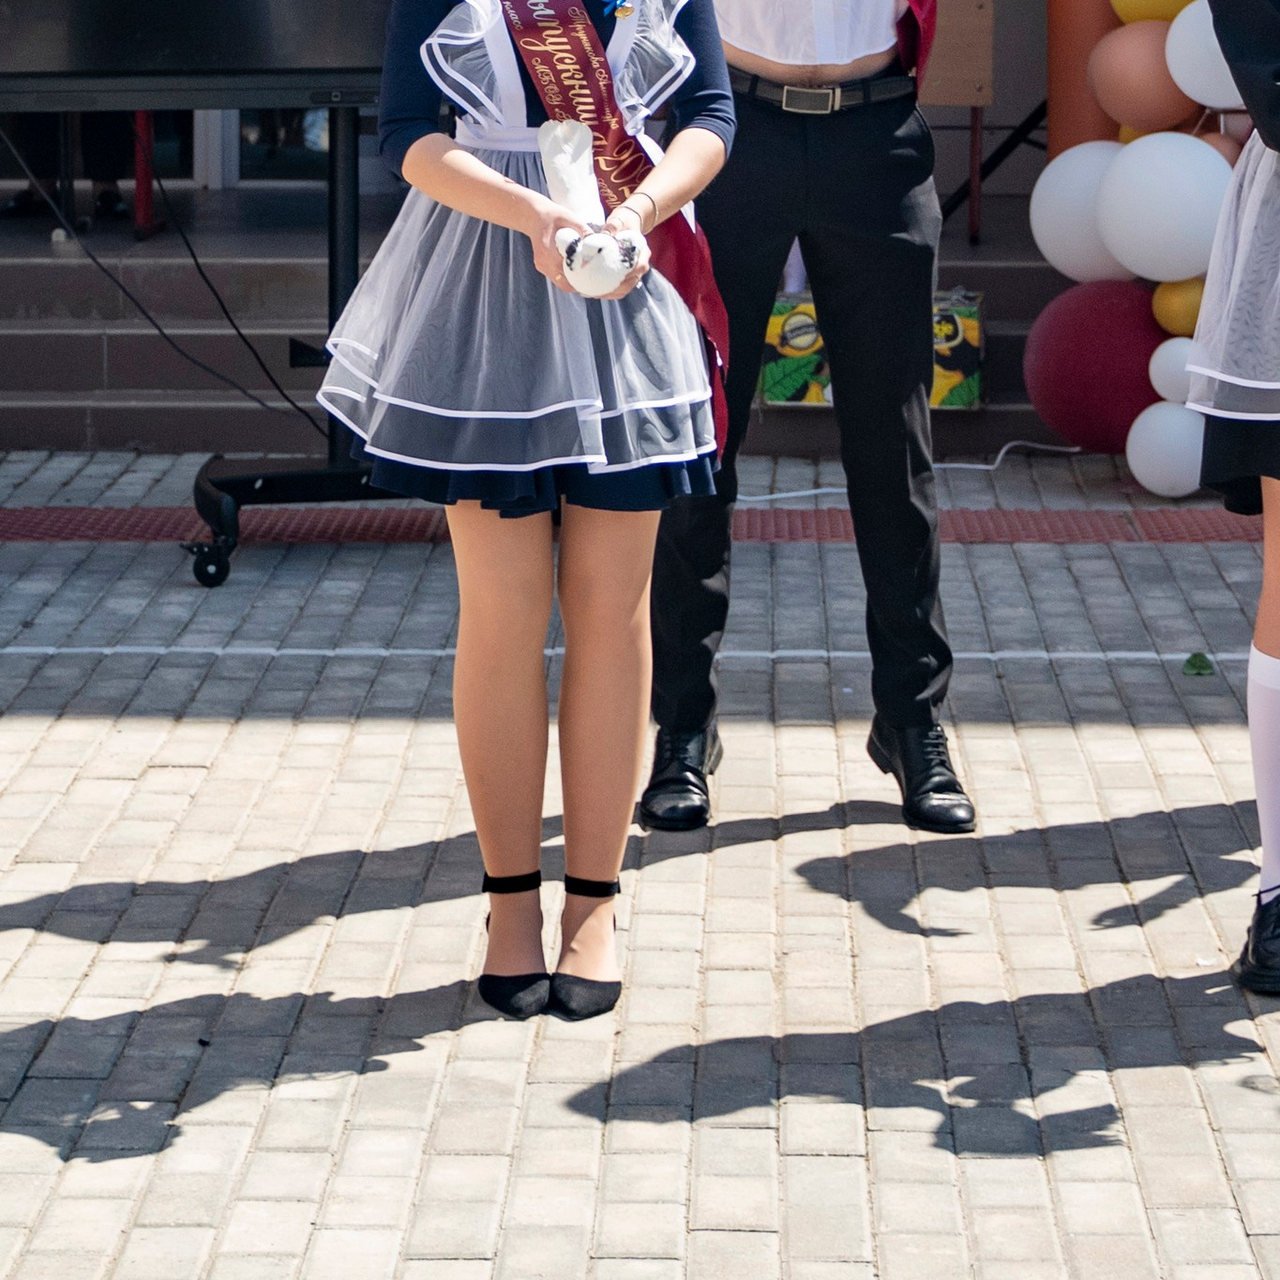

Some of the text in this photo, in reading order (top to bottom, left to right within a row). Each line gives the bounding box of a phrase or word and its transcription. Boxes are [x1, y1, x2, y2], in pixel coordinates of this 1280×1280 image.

[502, 0, 523, 29] класс
[532, 57, 563, 105] МБОУ
[594, 140, 652, 197] 202
